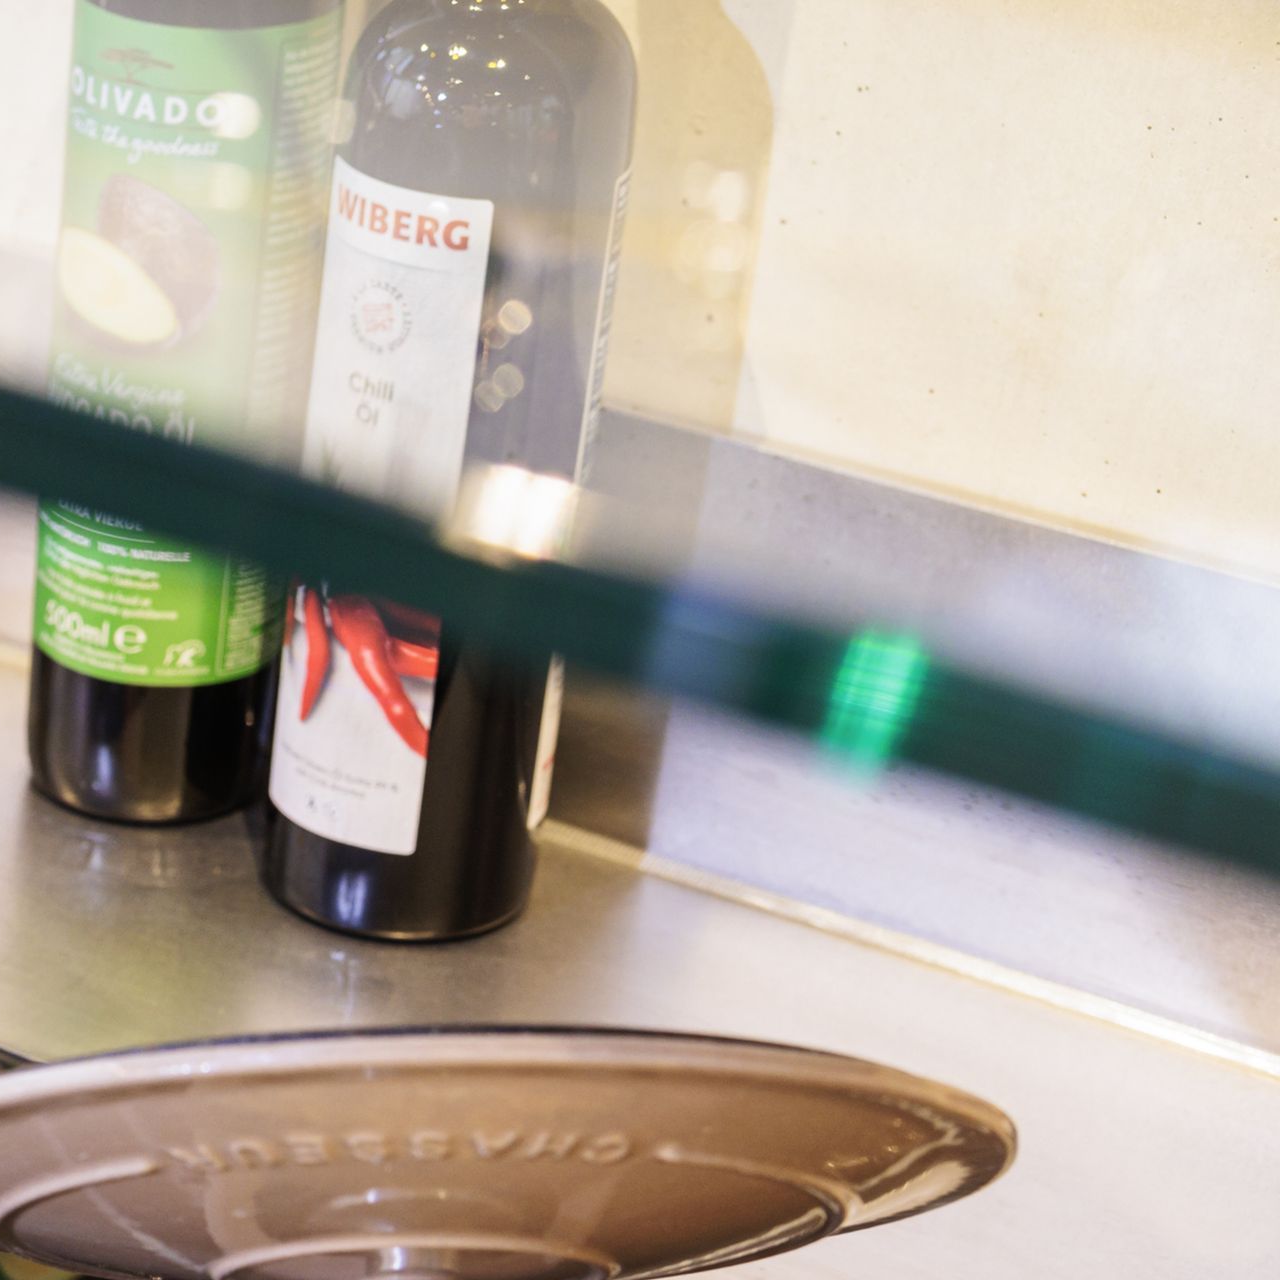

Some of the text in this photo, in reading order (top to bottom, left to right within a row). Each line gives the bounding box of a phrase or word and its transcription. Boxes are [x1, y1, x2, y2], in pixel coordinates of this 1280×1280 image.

[71, 65, 225, 128] OLIVADO
[337, 182, 471, 252] WIBERG
[348, 369, 396, 403] Chili
